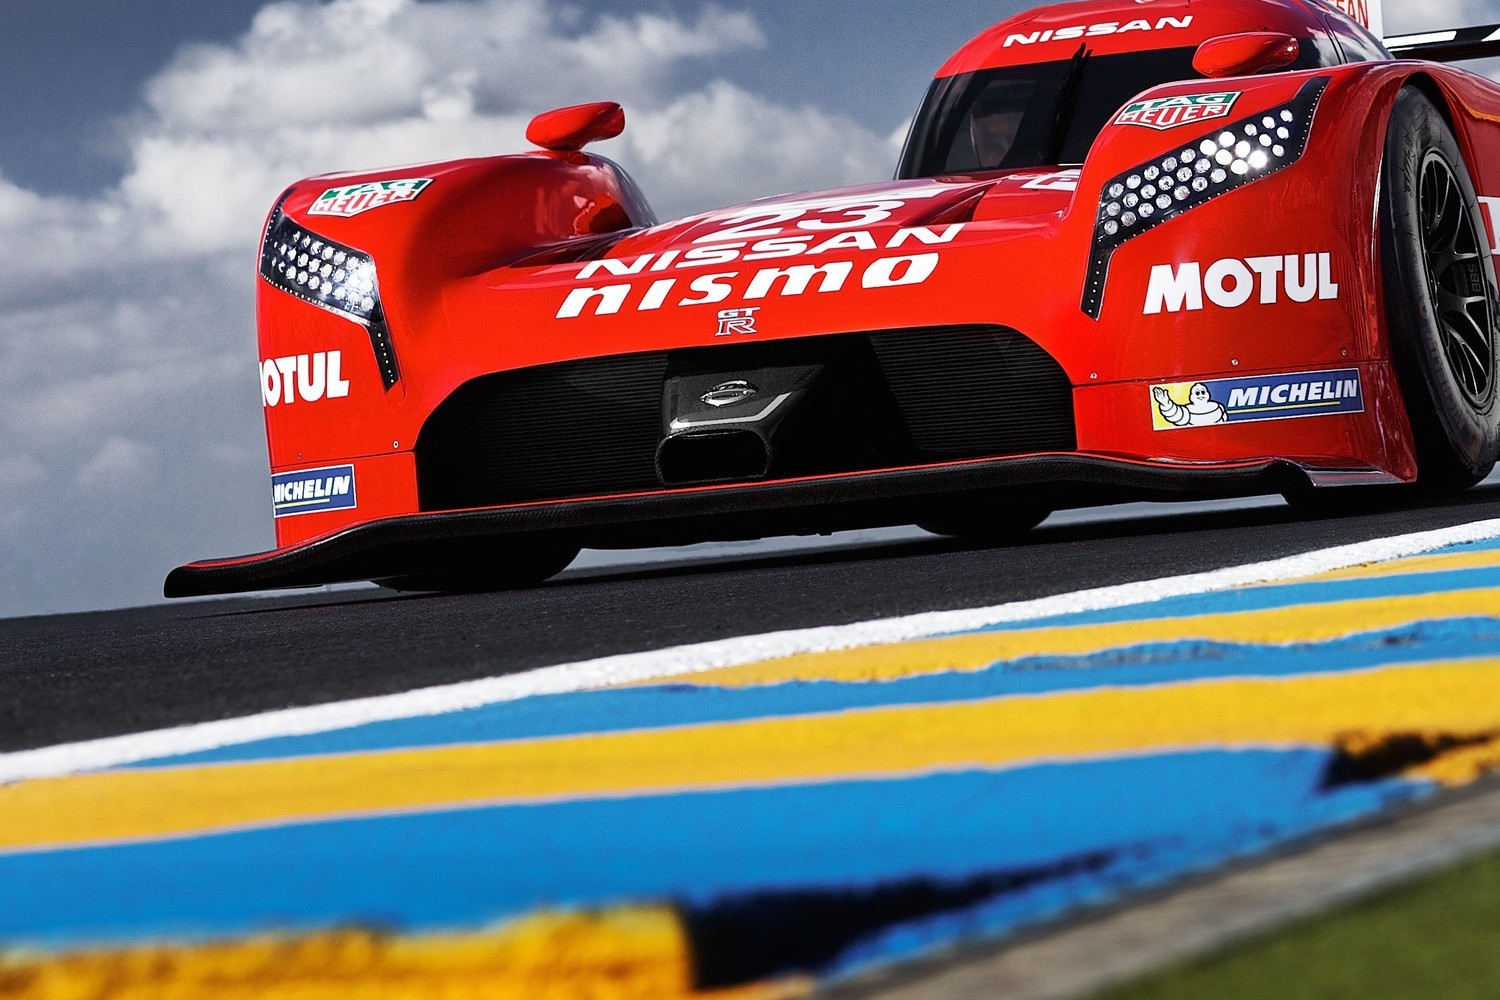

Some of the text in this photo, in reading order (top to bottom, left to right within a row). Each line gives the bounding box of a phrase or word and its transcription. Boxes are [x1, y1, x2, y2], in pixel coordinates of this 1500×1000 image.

[1002, 15, 1194, 48] NISSAN
[1121, 104, 1224, 126] HEUER
[1134, 93, 1228, 109] TAG
[313, 189, 413, 213] HEUER
[330, 179, 420, 197] TAG
[691, 199, 906, 245] 23
[574, 223, 966, 280] NISSAN
[555, 252, 940, 319] nismo
[1142, 252, 1339, 315] MOTUL
[717, 306, 761, 318] GT
[714, 317, 758, 337] R
[258, 350, 350, 408] OTUL
[1227, 379, 1358, 408] MICHELIN
